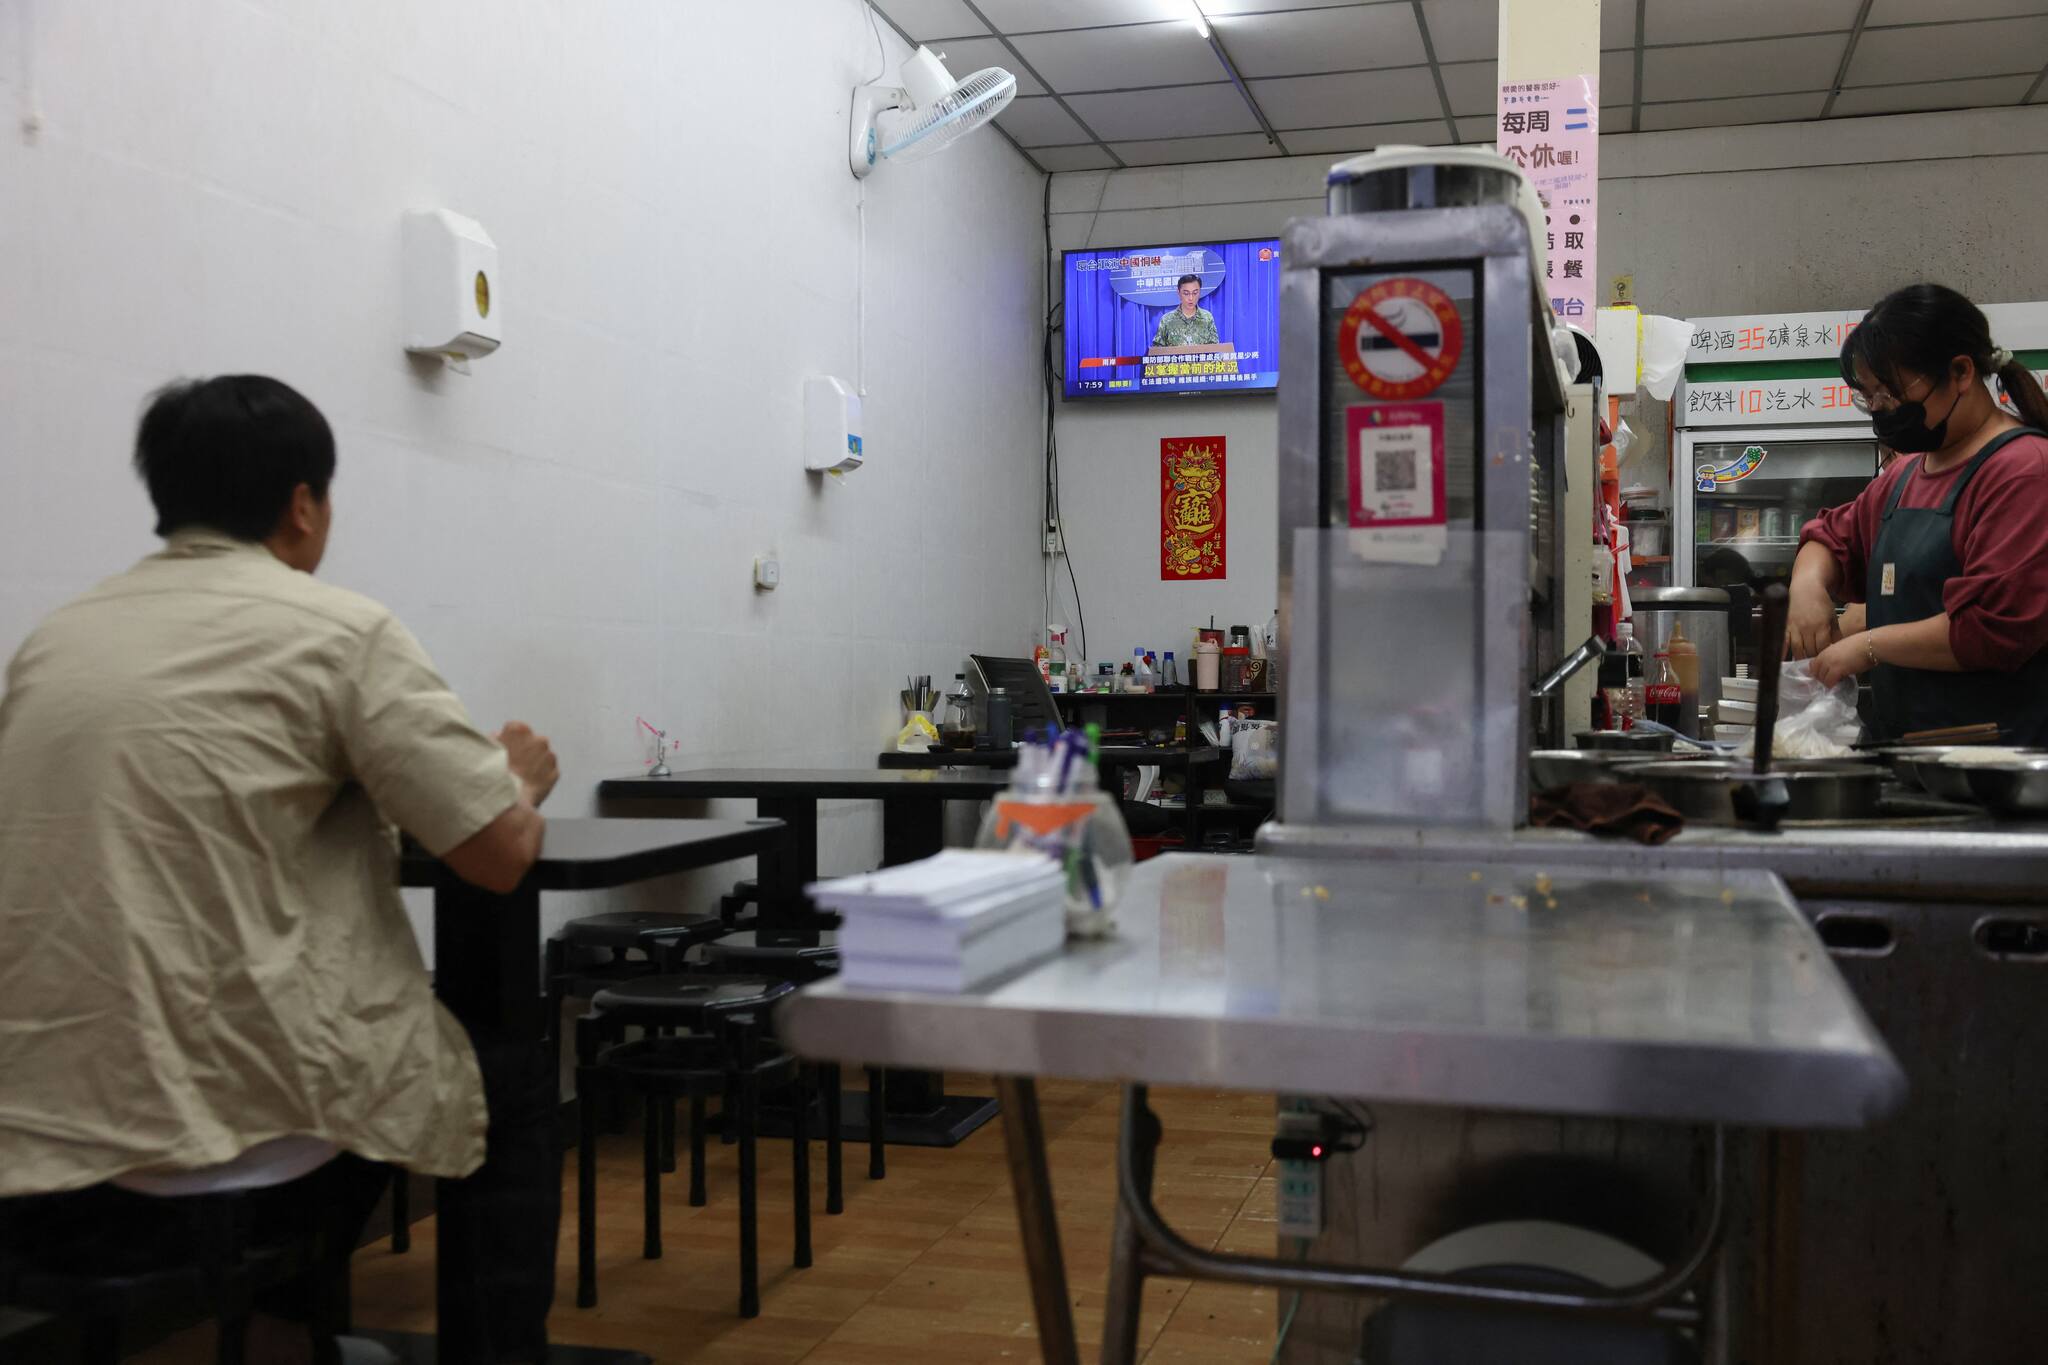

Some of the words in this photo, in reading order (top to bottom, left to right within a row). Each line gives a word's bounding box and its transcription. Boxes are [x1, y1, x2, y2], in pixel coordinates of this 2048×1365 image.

[1502, 110, 1550, 134] 每周
[1564, 108, 1588, 130] 二
[1690, 328, 1735, 354] 啤酒
[1738, 326, 1766, 350] 35
[1767, 322, 1833, 348] 礦泉水
[1078, 380, 1103, 390] 17:59
[1686, 389, 1736, 413] 飲料
